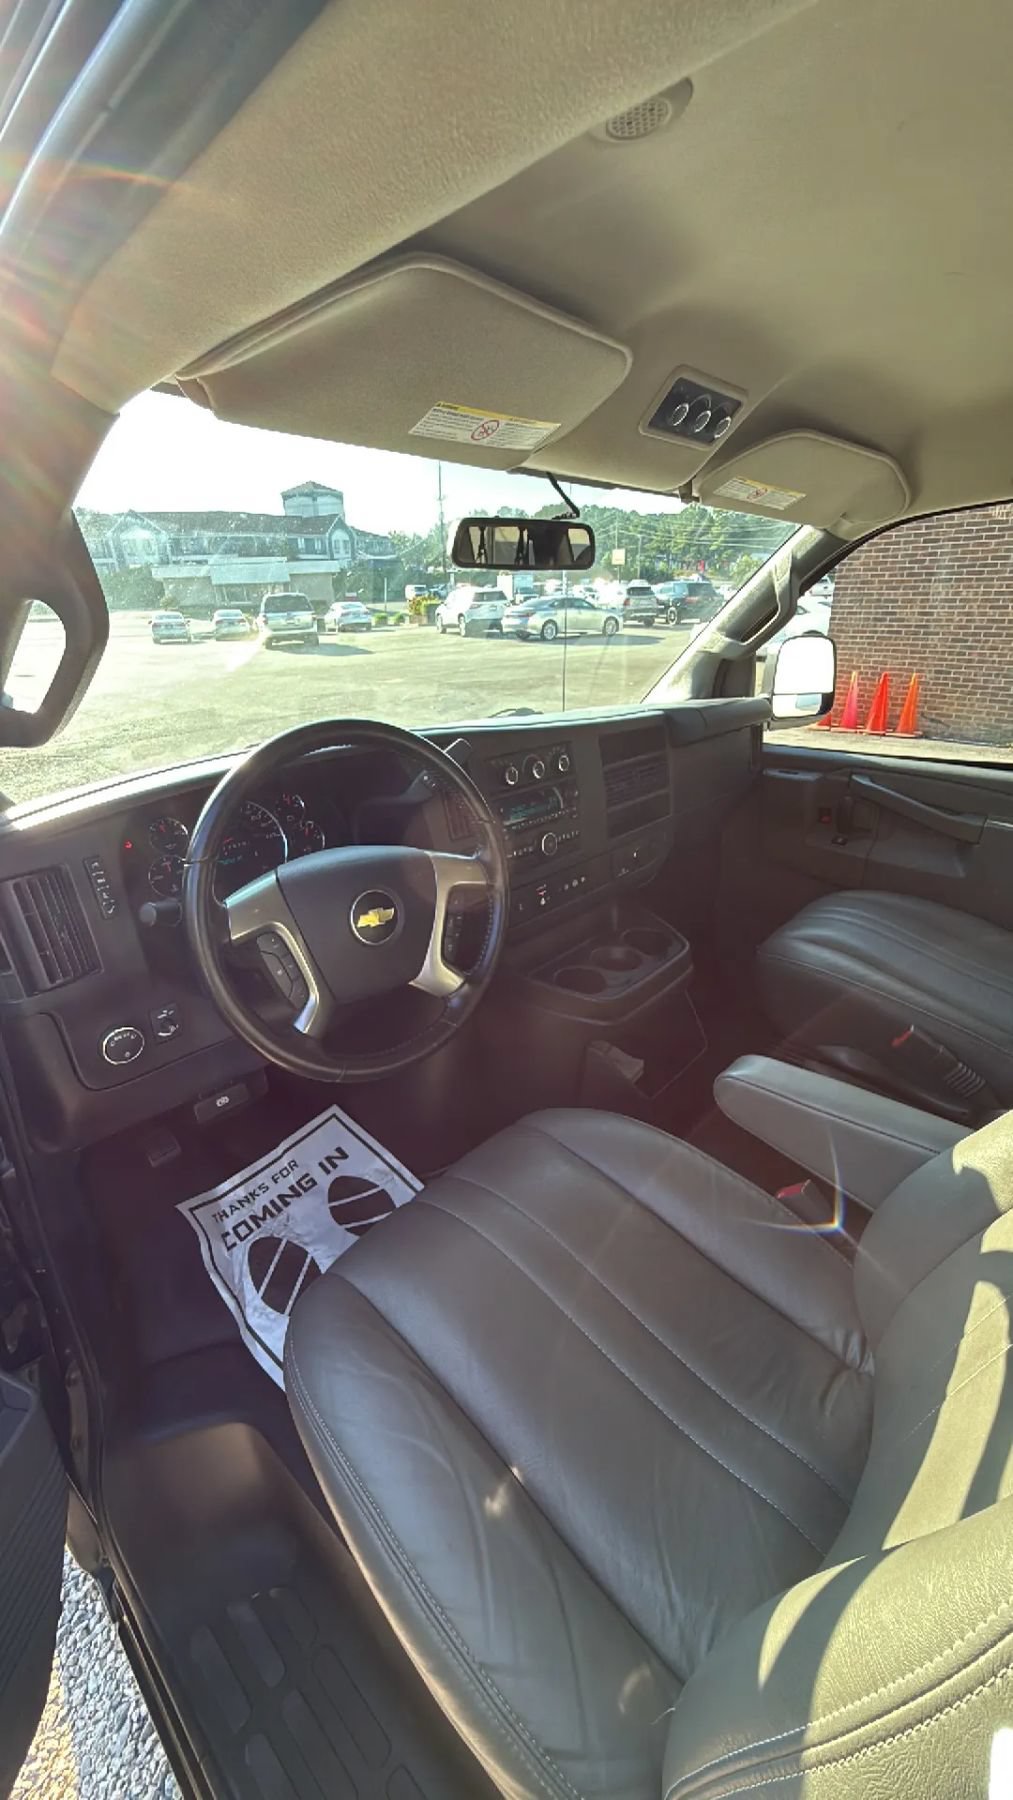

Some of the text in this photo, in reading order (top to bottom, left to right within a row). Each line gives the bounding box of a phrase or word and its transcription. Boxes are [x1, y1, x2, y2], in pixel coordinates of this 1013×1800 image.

[211, 1159, 299, 1224] THANKS FOR
[220, 1146, 349, 1251] COMING IN
